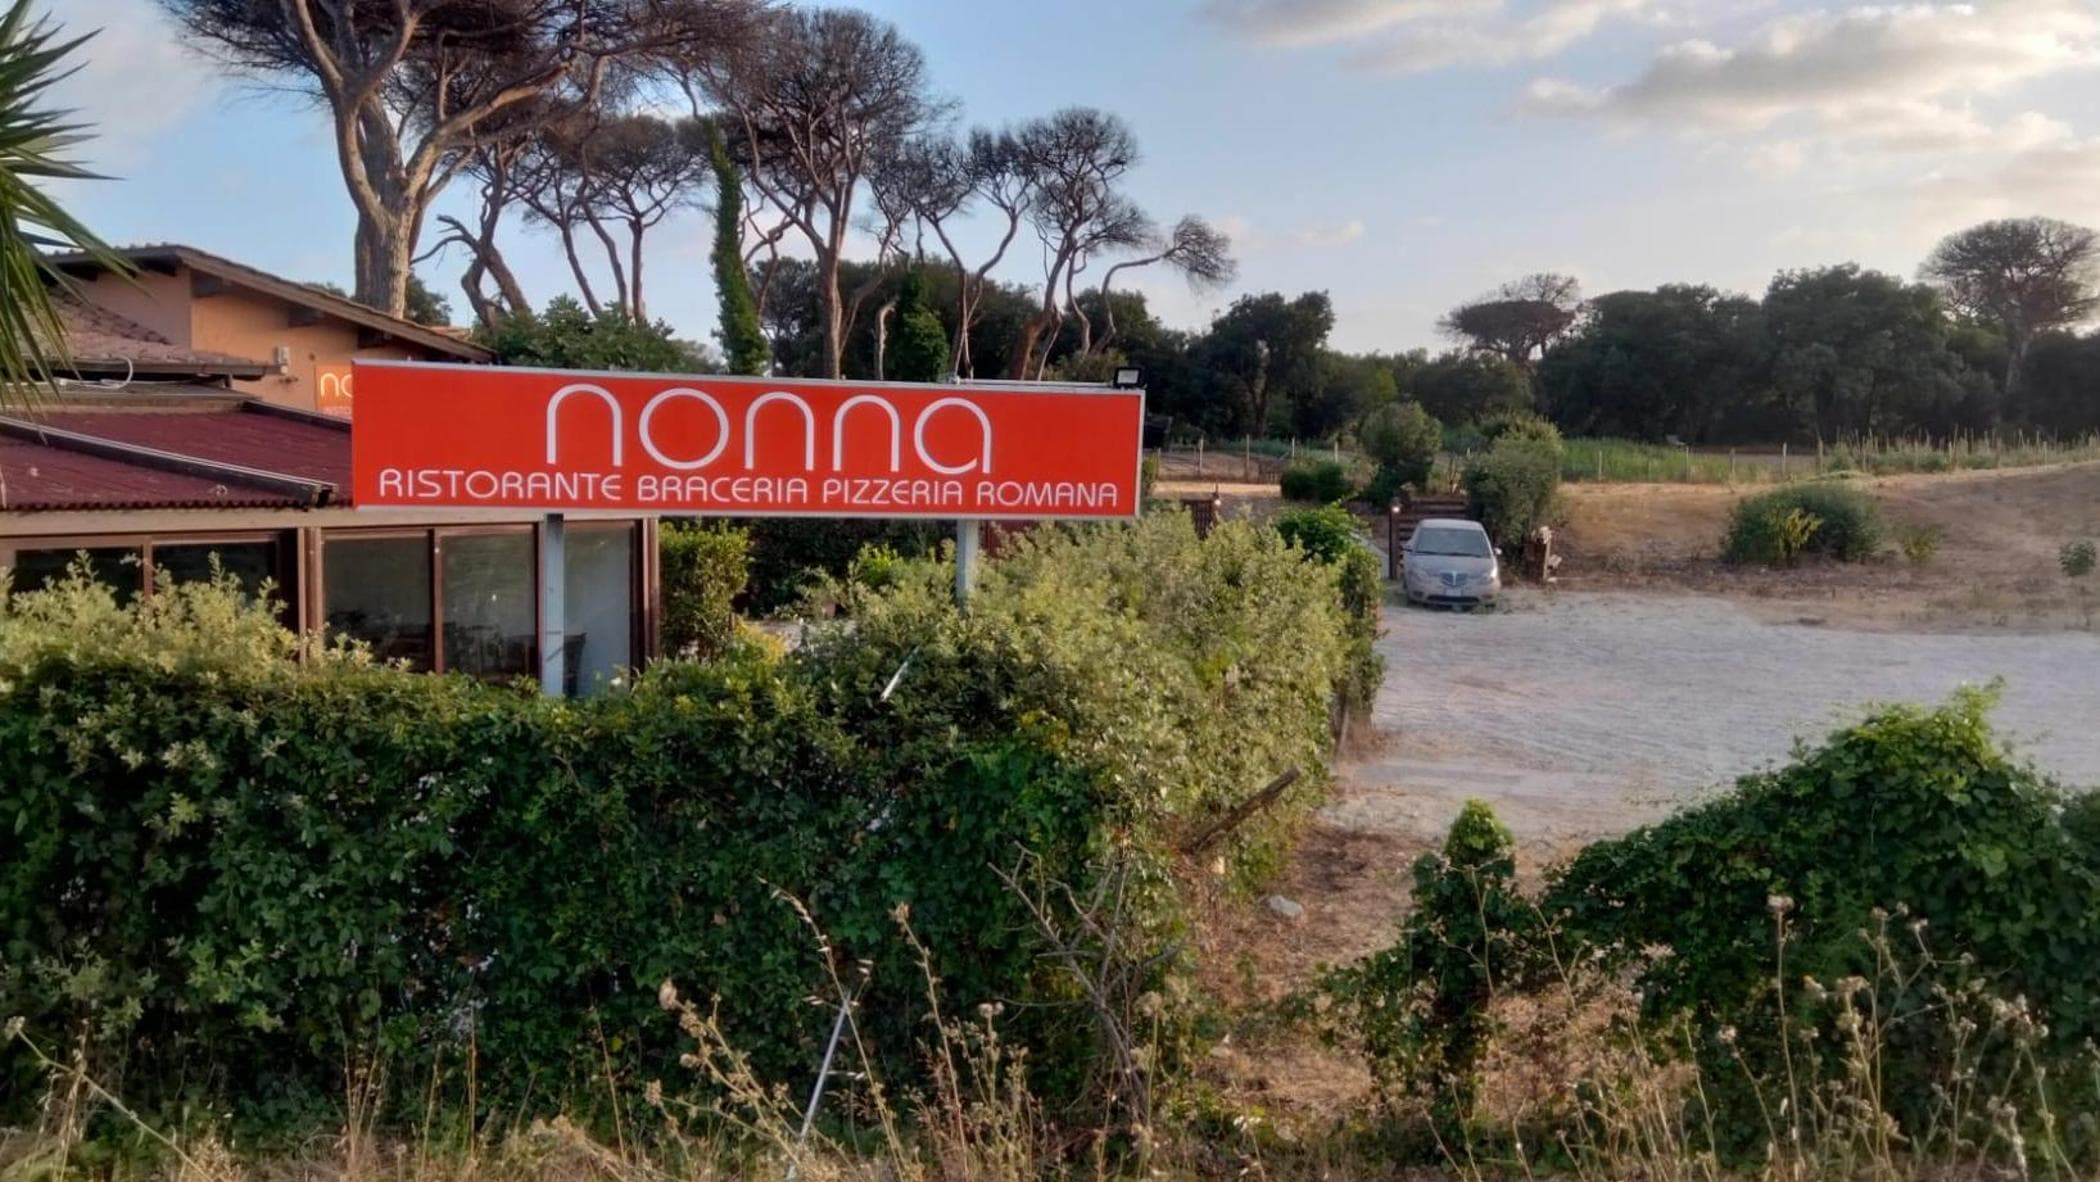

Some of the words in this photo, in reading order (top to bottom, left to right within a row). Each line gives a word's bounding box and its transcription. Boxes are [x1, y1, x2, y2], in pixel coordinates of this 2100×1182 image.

[546, 383, 992, 475] nonna
[379, 467, 623, 502] RISTORANTE
[636, 475, 808, 504] BRACERIA
[822, 478, 963, 507] PIZZERIA
[976, 481, 1118, 508] ROMANA
